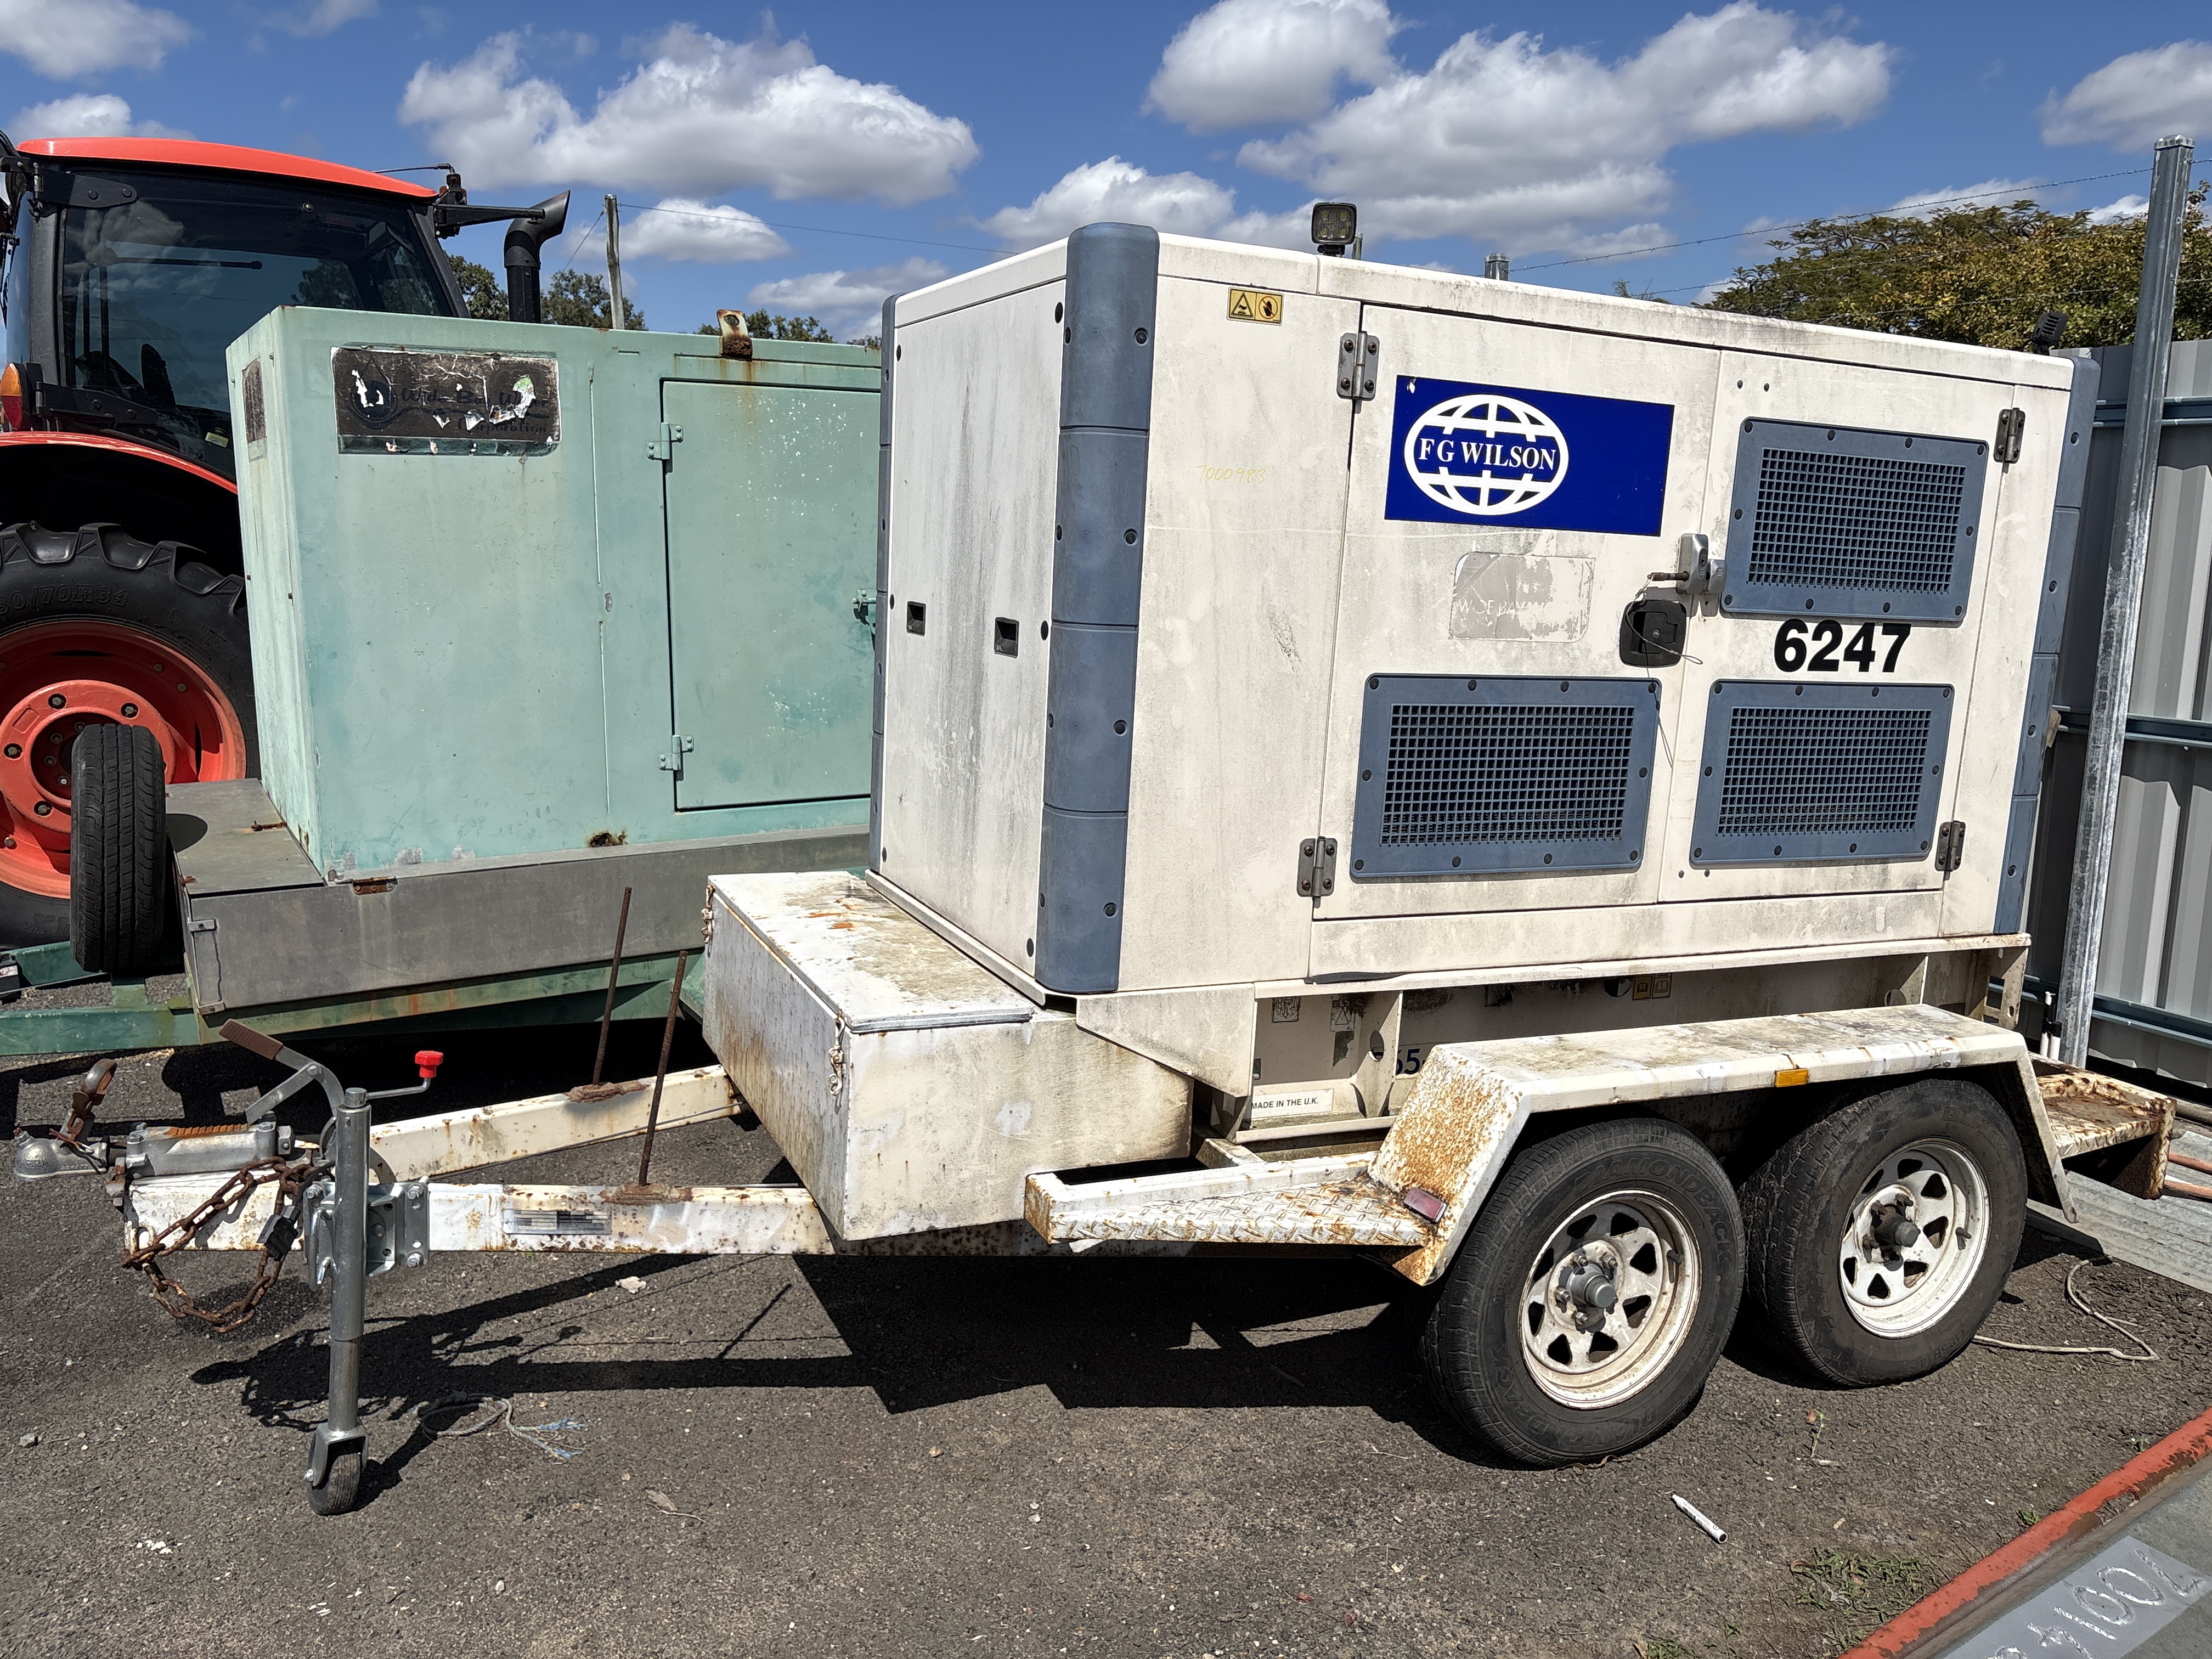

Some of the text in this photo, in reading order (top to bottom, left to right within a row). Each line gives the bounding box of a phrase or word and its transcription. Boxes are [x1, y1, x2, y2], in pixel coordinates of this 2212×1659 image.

[1461, 441, 1556, 470] WILSON
[1195, 465, 1266, 484] 7000983
[1774, 618, 1911, 673] 6247
[1251, 1101, 1274, 1109] MADE
[1304, 1097, 1319, 1105] U.K.
[1575, 1158, 1732, 1262] DIAMONDBACK
